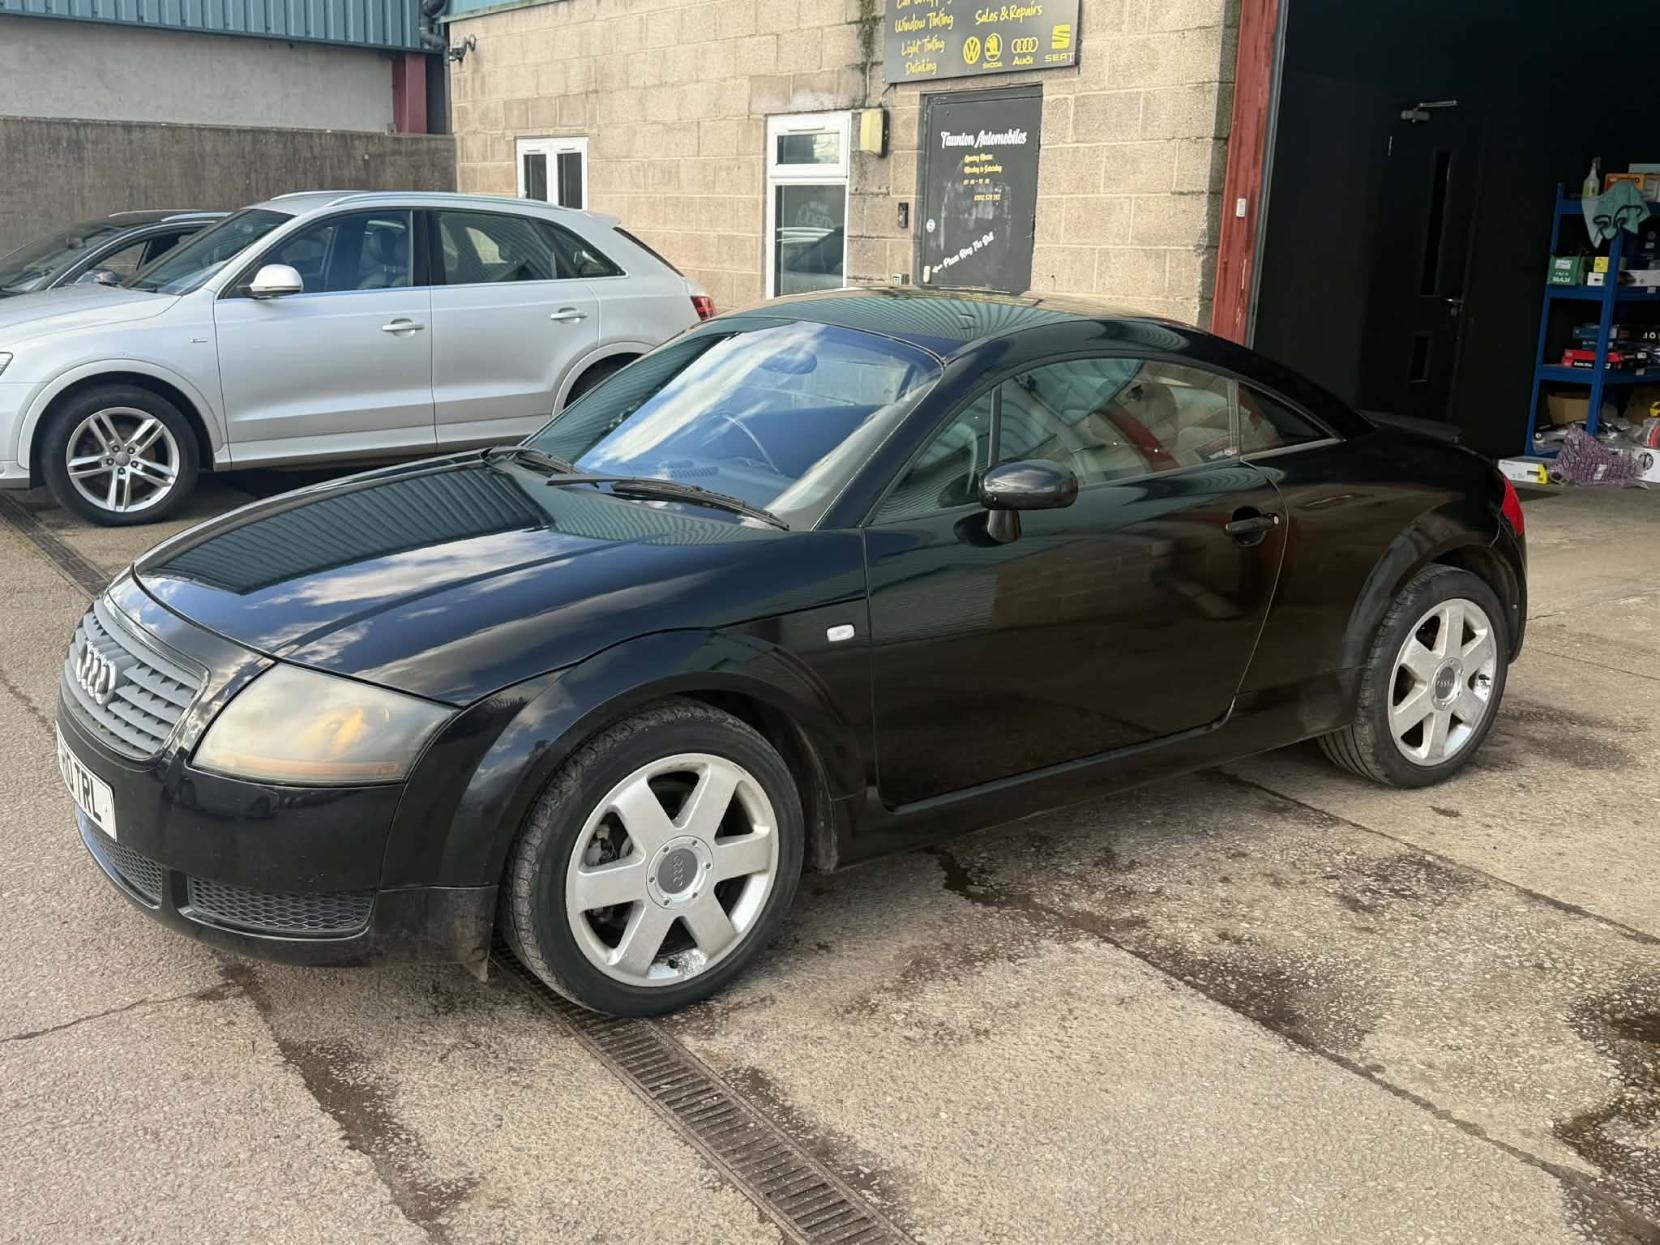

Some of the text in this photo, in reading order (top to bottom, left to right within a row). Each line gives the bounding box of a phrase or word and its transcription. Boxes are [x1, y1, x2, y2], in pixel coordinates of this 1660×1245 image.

[894, 7, 954, 33] Window Tinting
[975, 1, 1043, 25] Sales & Repairs
[901, 33, 945, 58] Light Tinting
[1044, 51, 1074, 63] SEAT
[1012, 55, 1034, 66] Audi
[973, 128, 1028, 149] Automobiles
[74, 760, 102, 823] TRL
